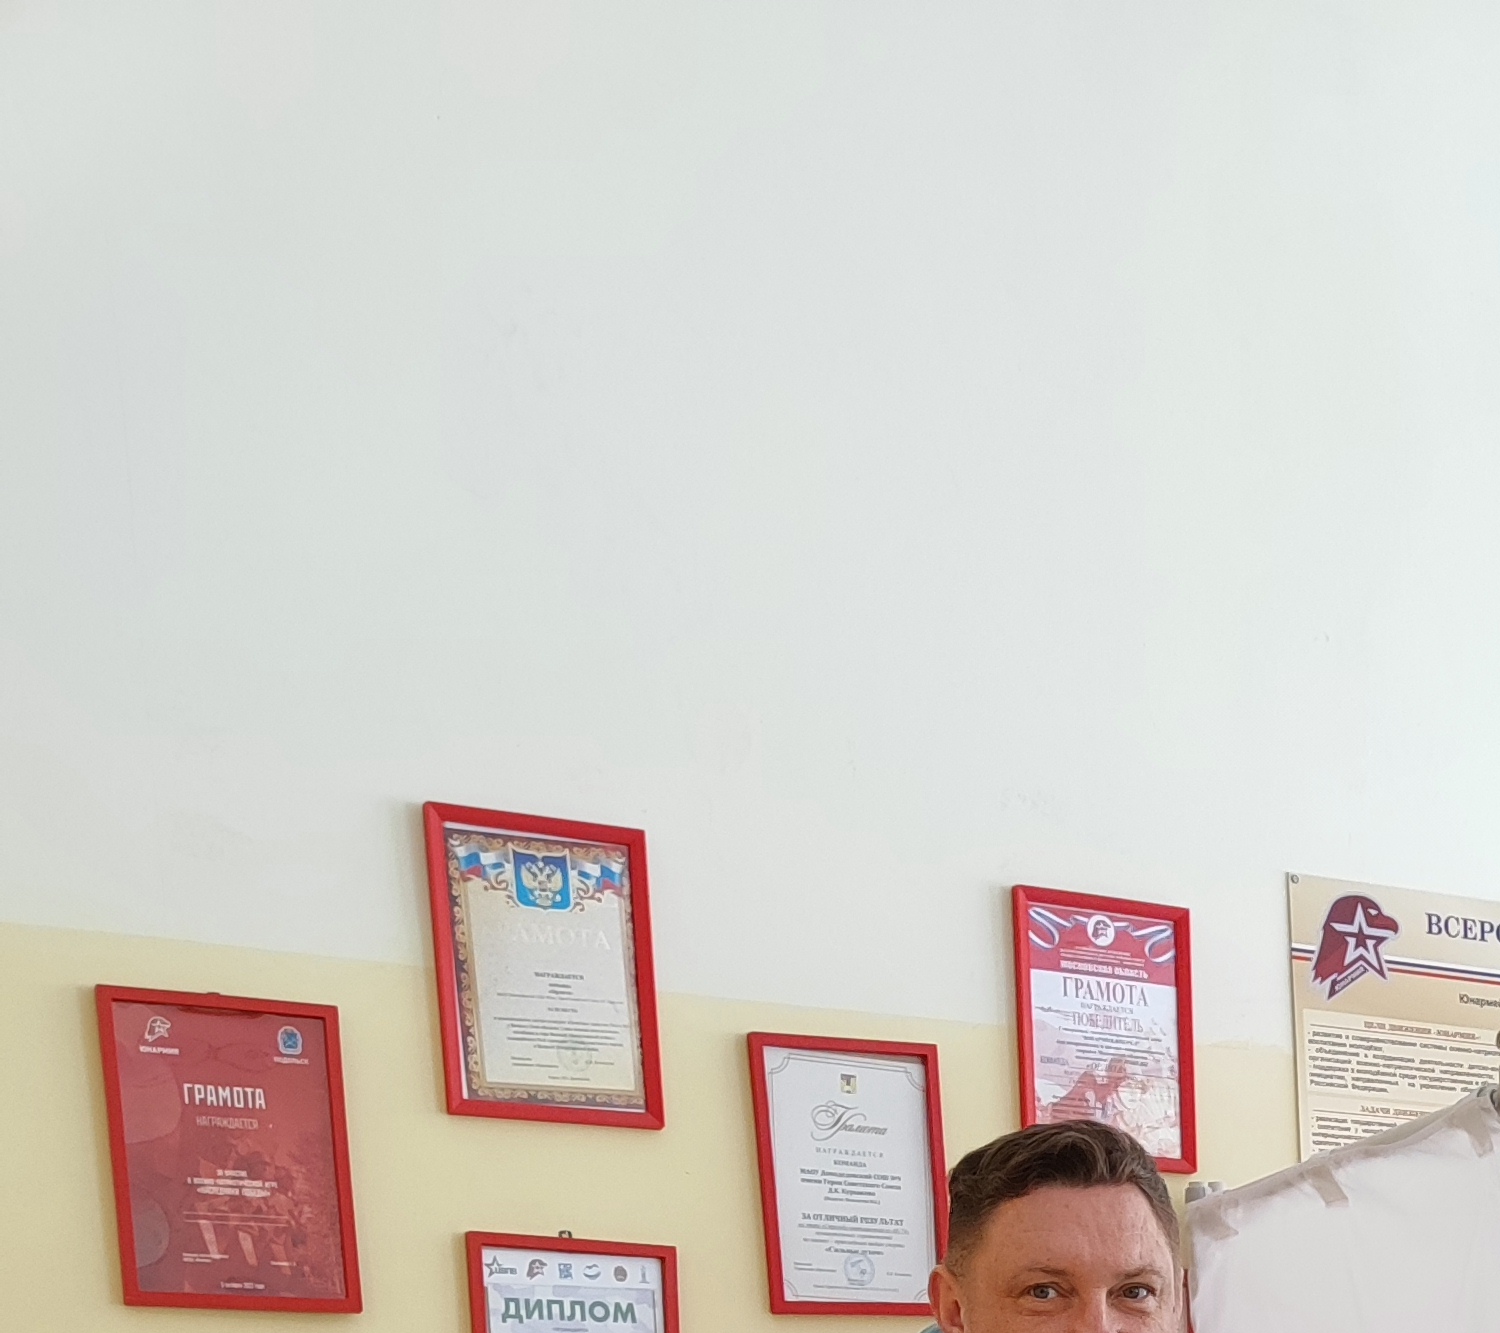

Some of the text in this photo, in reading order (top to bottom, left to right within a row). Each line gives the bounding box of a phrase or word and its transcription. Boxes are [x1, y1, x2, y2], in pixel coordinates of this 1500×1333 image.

[1062, 976, 1149, 1007] ГРАМОТА
[1072, 1012, 1144, 1034] ПОБЕДИТЕЛЬ
[182, 1082, 267, 1110] ГРАМОТА
[195, 1115, 259, 1130] НАГРАЖДАЕТСЯ
[810, 1099, 889, 1142] Грамота
[501, 1297, 638, 1325] ДИПЛОМ
